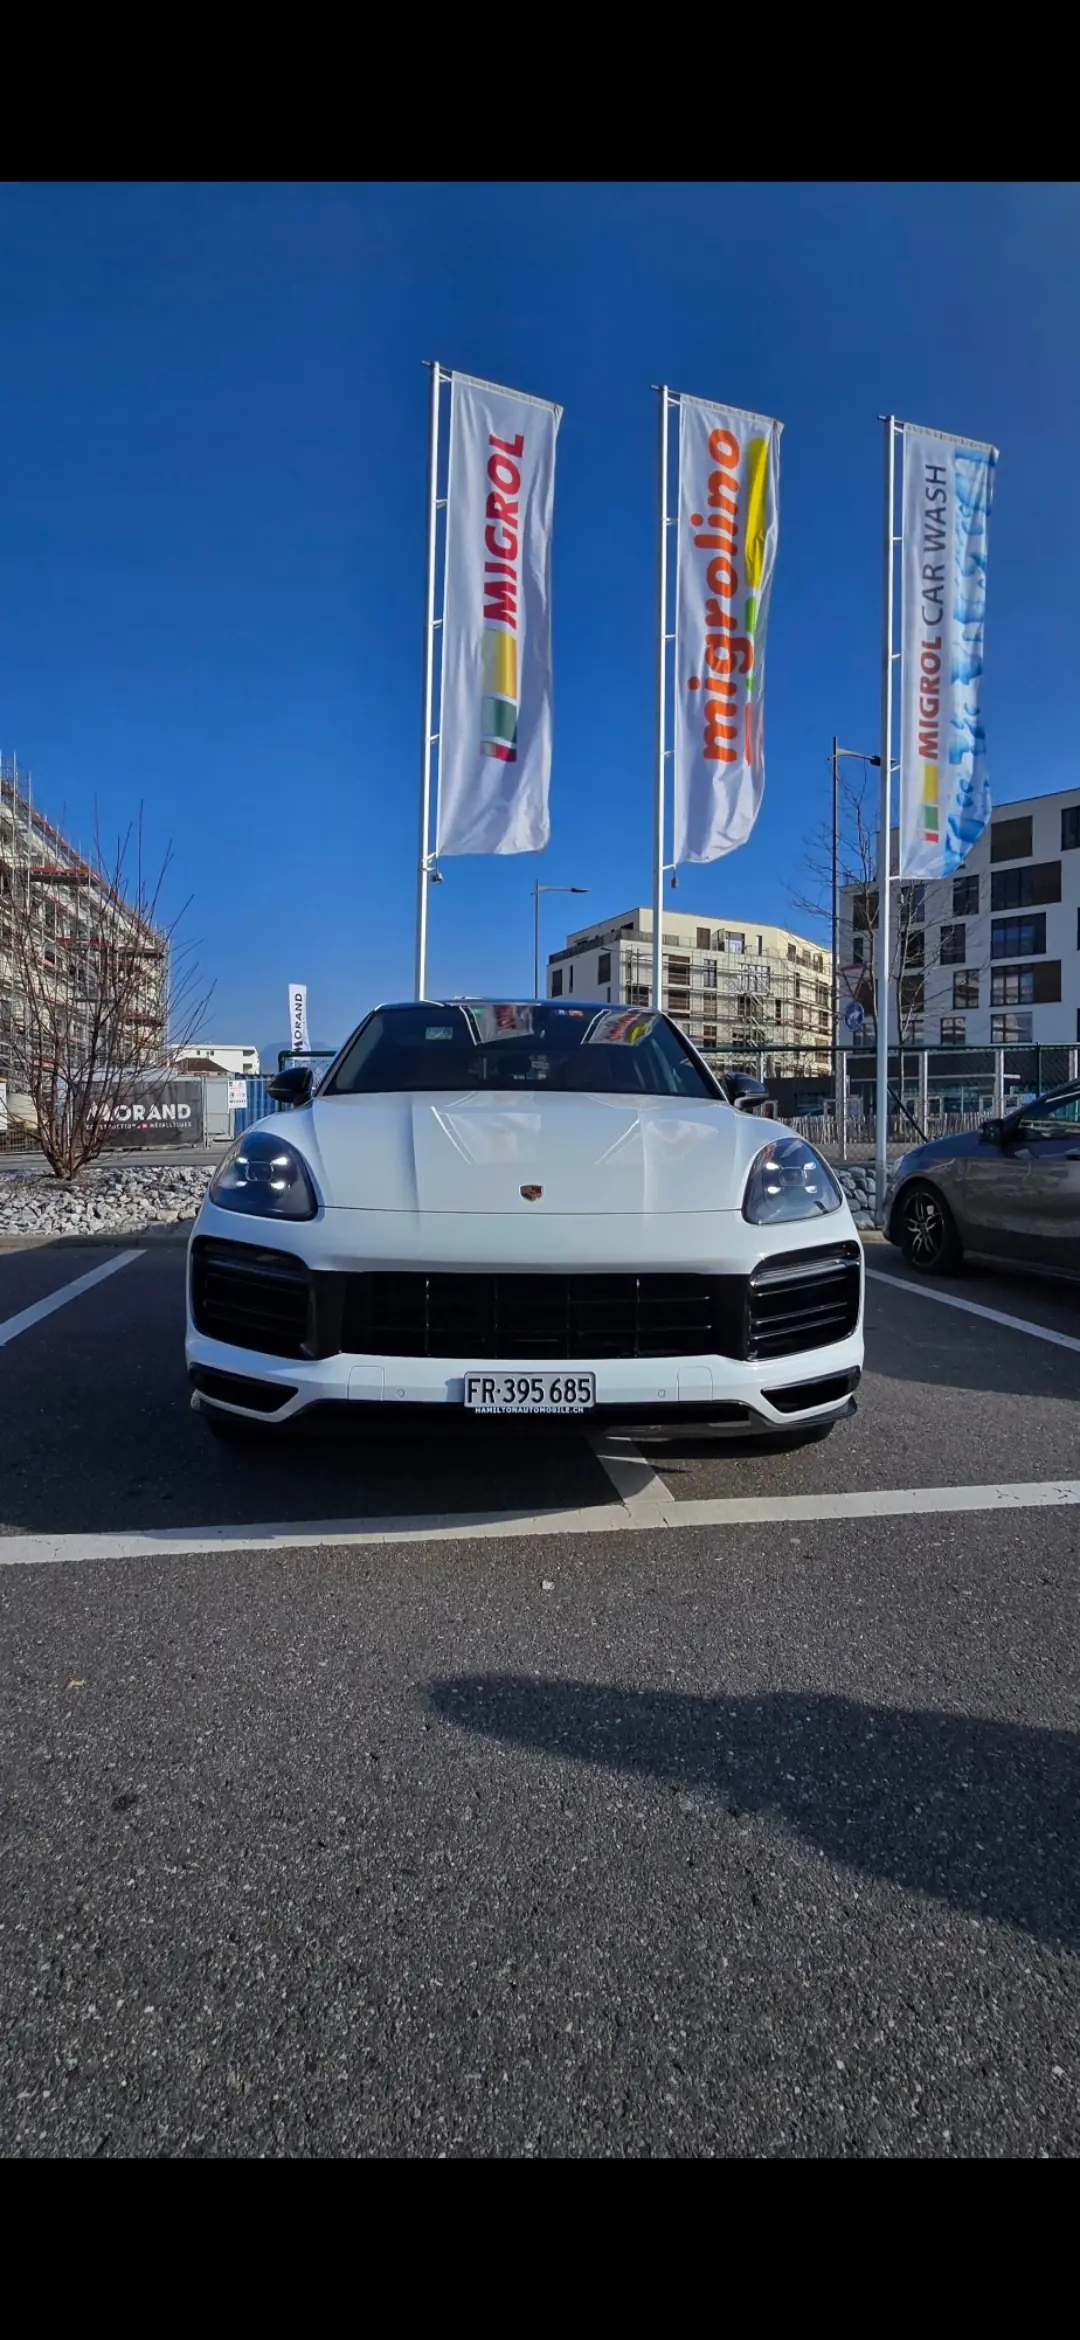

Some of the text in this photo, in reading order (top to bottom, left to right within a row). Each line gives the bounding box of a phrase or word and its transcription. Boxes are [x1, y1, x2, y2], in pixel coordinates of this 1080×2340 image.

[483, 433, 525, 630] MIGROL
[687, 428, 754, 763] migrolino
[918, 464, 947, 760] MIGROL CAR WASH
[293, 993, 304, 1053] MORAND
[86, 1101, 192, 1121] MORAND
[550, 1378, 591, 1404] 685
